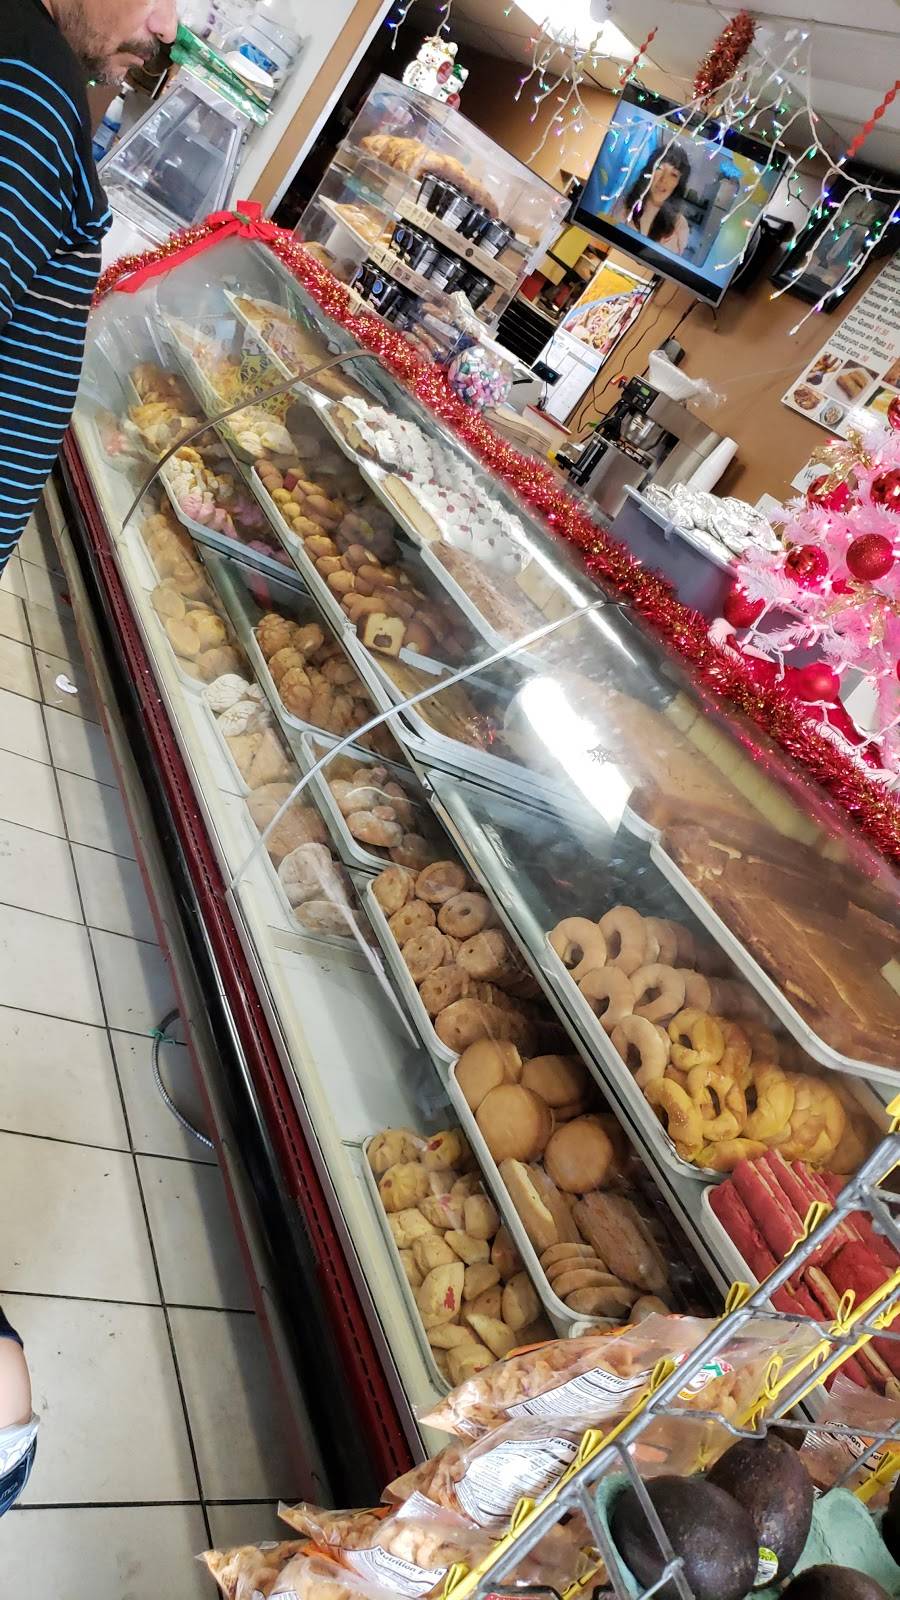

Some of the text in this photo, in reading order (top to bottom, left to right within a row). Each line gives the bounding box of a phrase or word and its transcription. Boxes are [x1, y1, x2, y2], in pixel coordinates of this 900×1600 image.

[841, 321, 866, 338] Desayuno
[857, 318, 875, 330] Queso
[834, 330, 859, 346] Desayuno
[846, 347, 860, 359] Extra
[377, 1547, 417, 1573] Nutrition
